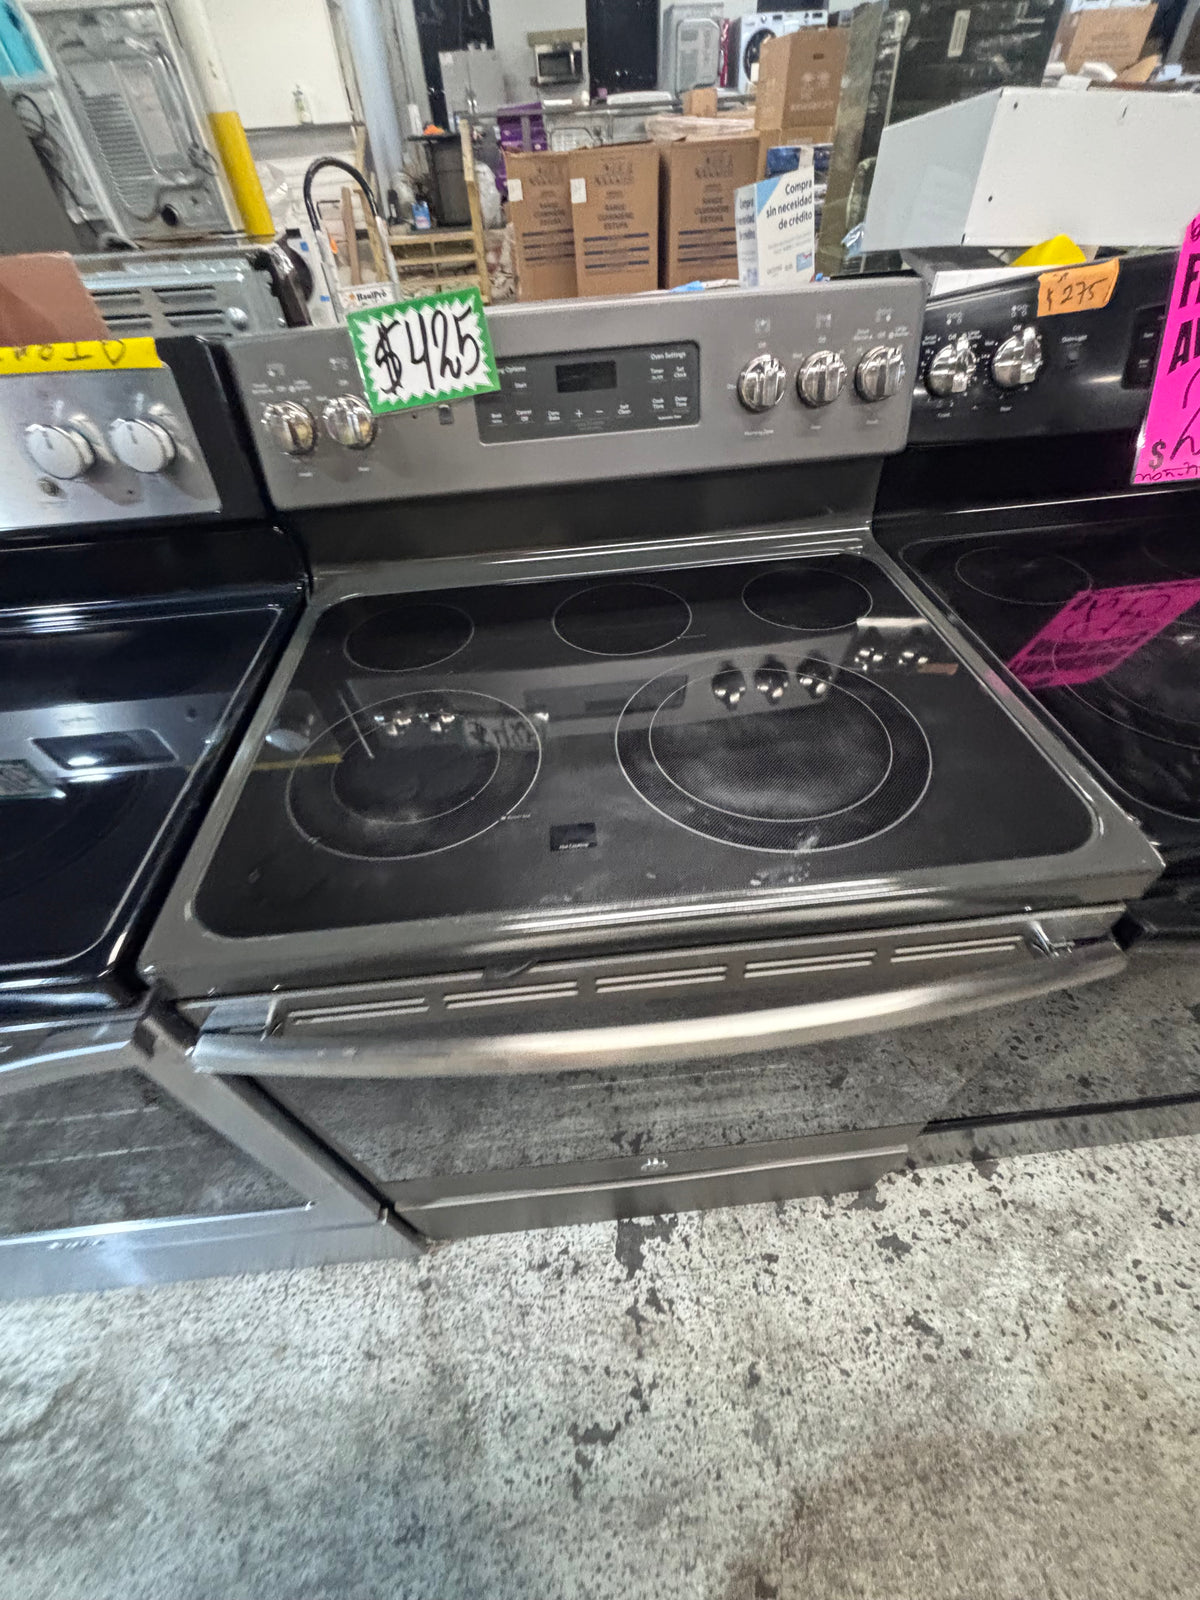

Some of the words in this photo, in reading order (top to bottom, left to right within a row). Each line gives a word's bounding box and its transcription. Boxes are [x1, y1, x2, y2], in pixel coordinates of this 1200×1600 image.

[785, 179, 812, 196] Compra
[766, 204, 777, 219] sin
[778, 193, 812, 215] necesidad
[778, 217, 788, 230] de
[789, 210, 812, 227] crédito
[375, 305, 480, 396] $425
[665, 351, 687, 360] Settings
